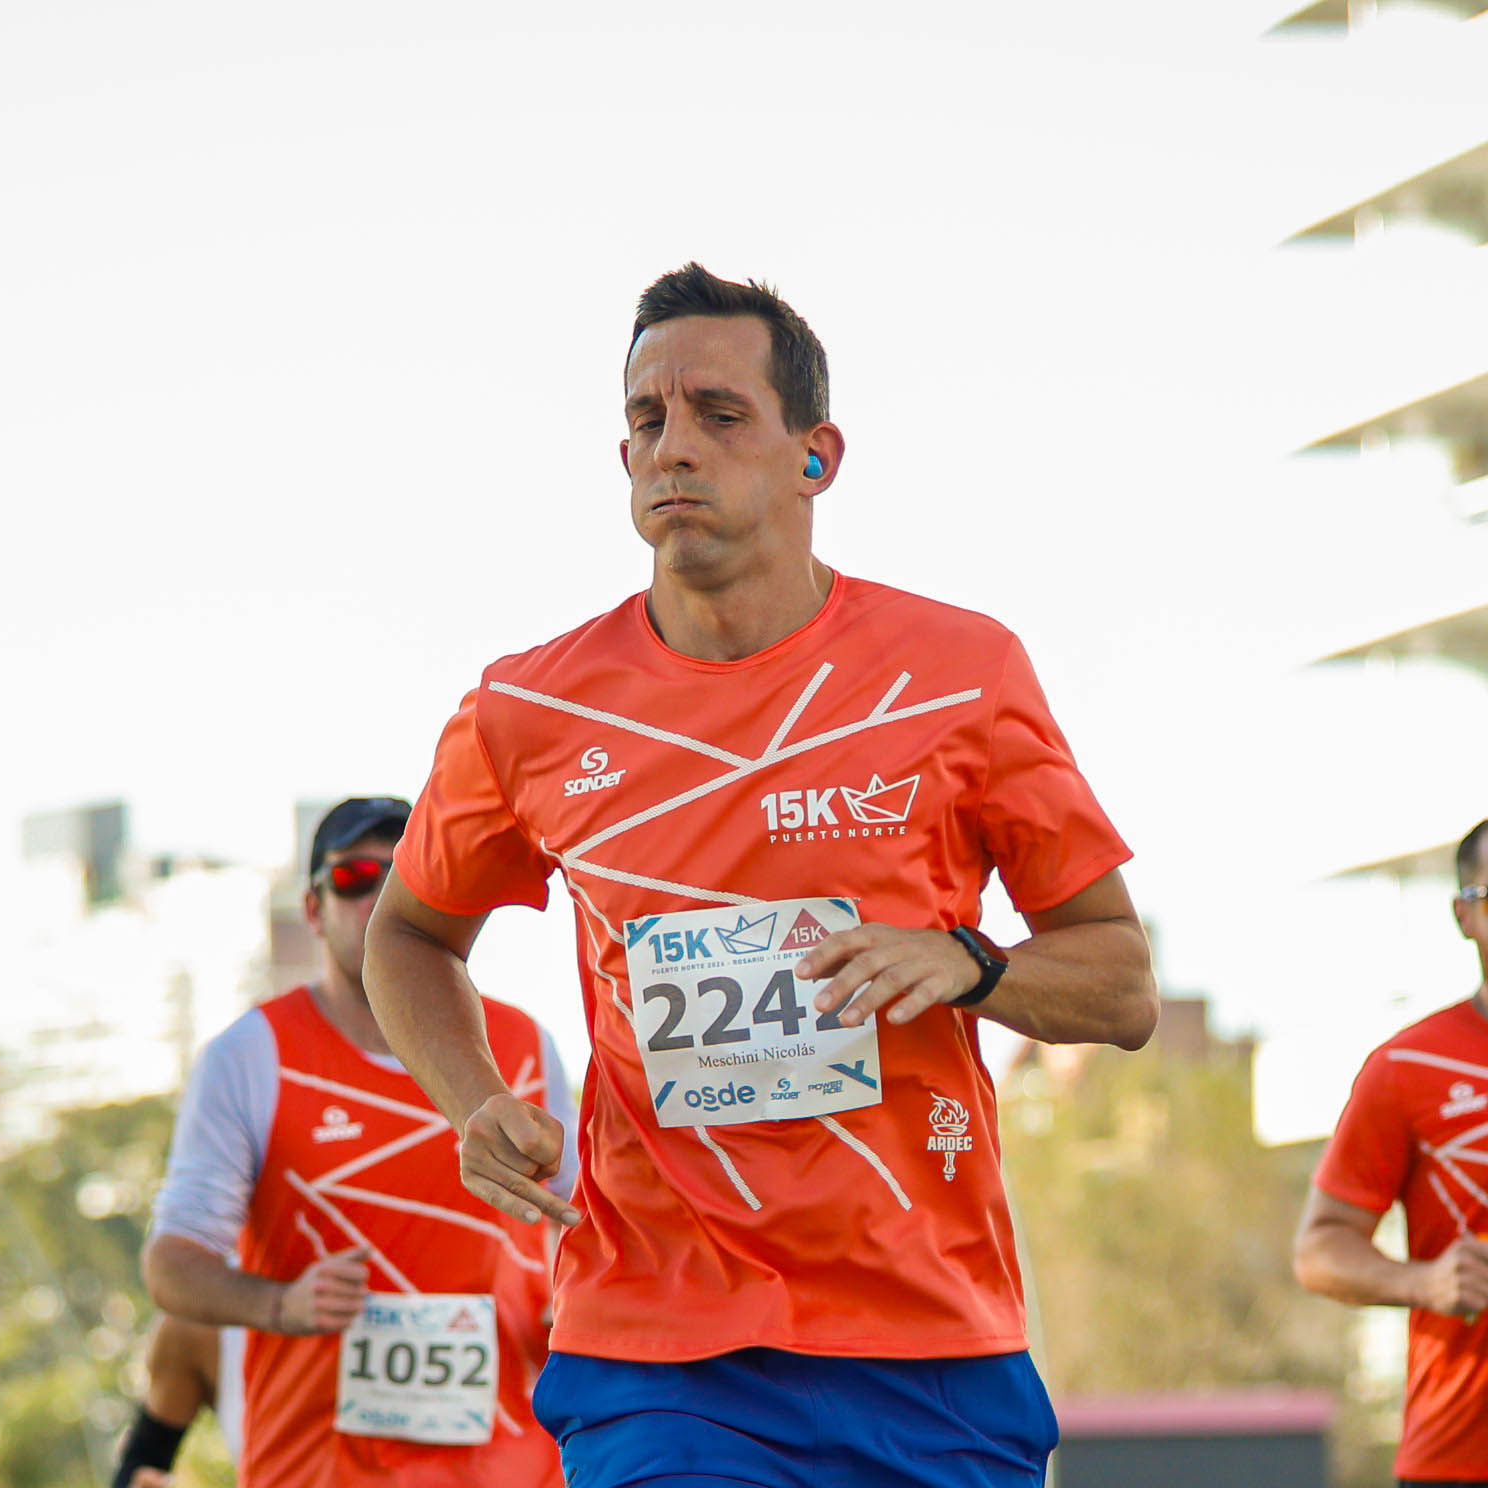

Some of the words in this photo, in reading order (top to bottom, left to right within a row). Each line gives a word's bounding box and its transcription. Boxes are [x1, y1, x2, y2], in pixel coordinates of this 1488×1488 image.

[761, 787, 840, 831] 15K
[770, 829, 841, 843] PUERTO
[848, 826, 907, 839] NORTE
[648, 927, 712, 964] 15K
[790, 925, 824, 945] 15K
[651, 966, 679, 976] PUERTO
[681, 963, 705, 972] NORTE
[732, 956, 765, 966] ROSARIO
[698, 1049, 760, 1069] Meschini
[763, 1043, 816, 1062] Nicolás
[684, 1080, 756, 1110] osde
[927, 1136, 973, 1151] ARDEC
[349, 1338, 490, 1386] 1052
